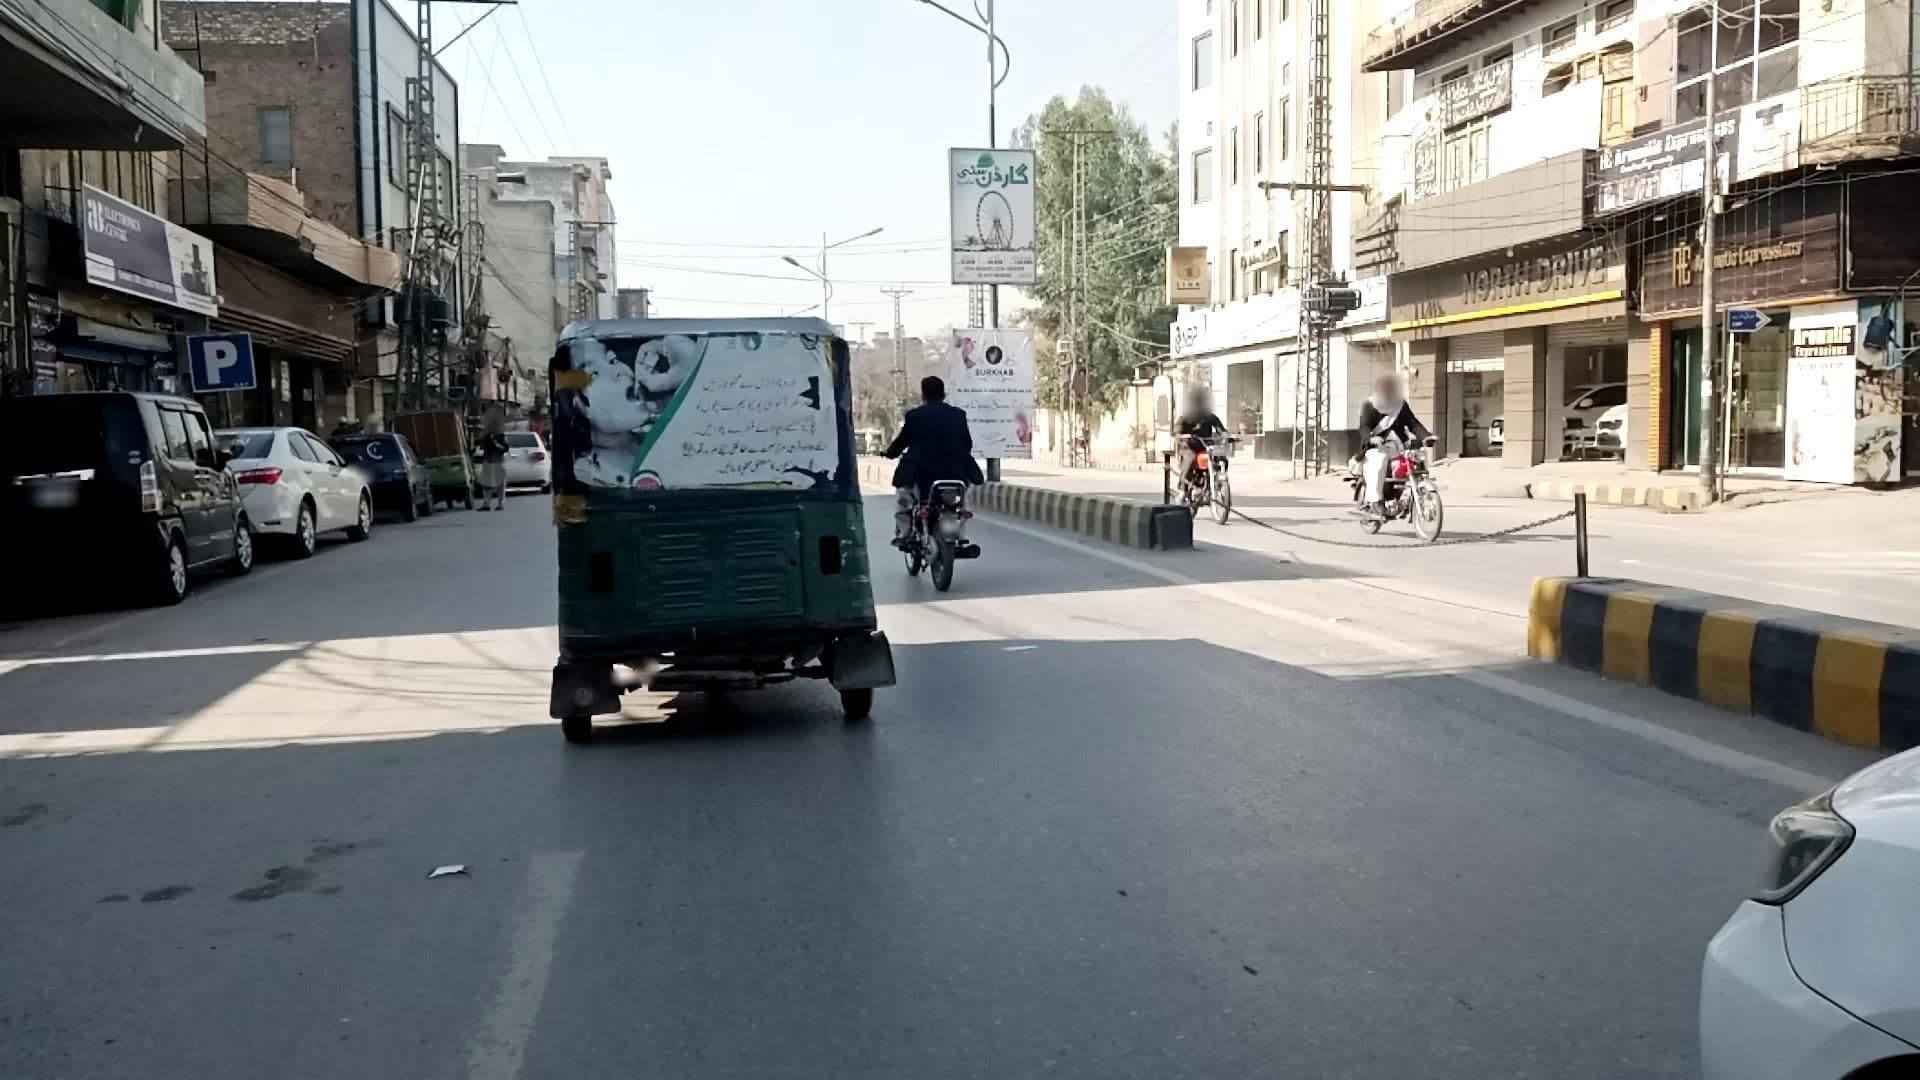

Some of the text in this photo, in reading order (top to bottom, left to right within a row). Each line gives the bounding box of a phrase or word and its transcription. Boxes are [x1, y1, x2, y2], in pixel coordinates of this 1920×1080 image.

[1738, 240, 1804, 267] Expressions
[1462, 246, 1606, 305] NORTH DRIVE
[1794, 326, 1852, 346] Aromatic
[202, 340, 238, 384] P
[1795, 345, 1849, 358] Expressions
